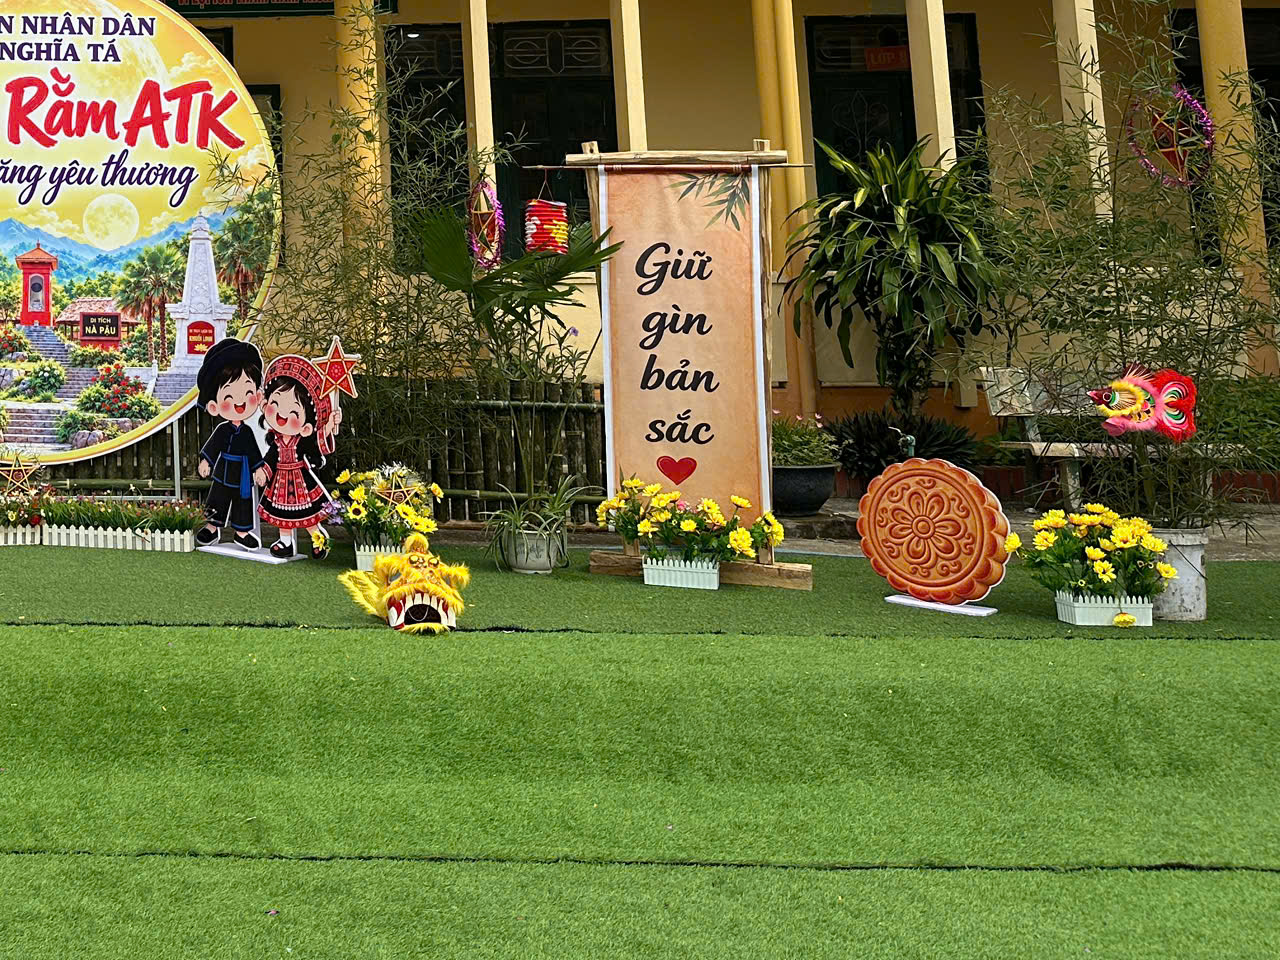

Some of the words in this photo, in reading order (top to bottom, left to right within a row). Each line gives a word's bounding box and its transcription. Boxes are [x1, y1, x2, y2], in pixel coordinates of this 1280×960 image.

[22, 13, 93, 35] NHÂN
[103, 14, 155, 35] DÂN
[0, 39, 80, 61] NGHĨA
[88, 39, 119, 61] TÁ
[6, 68, 118, 147] Rằm
[123, 80, 244, 148] ATK
[47, 164, 98, 206] yêu
[101, 150, 198, 208] thương
[636, 243, 712, 295] Giữ
[85, 324, 97, 334] NÀ
[99, 326, 116, 337] PẬU
[639, 305, 712, 350] gìn
[640, 354, 719, 392] bản
[646, 409, 714, 444] sắc
